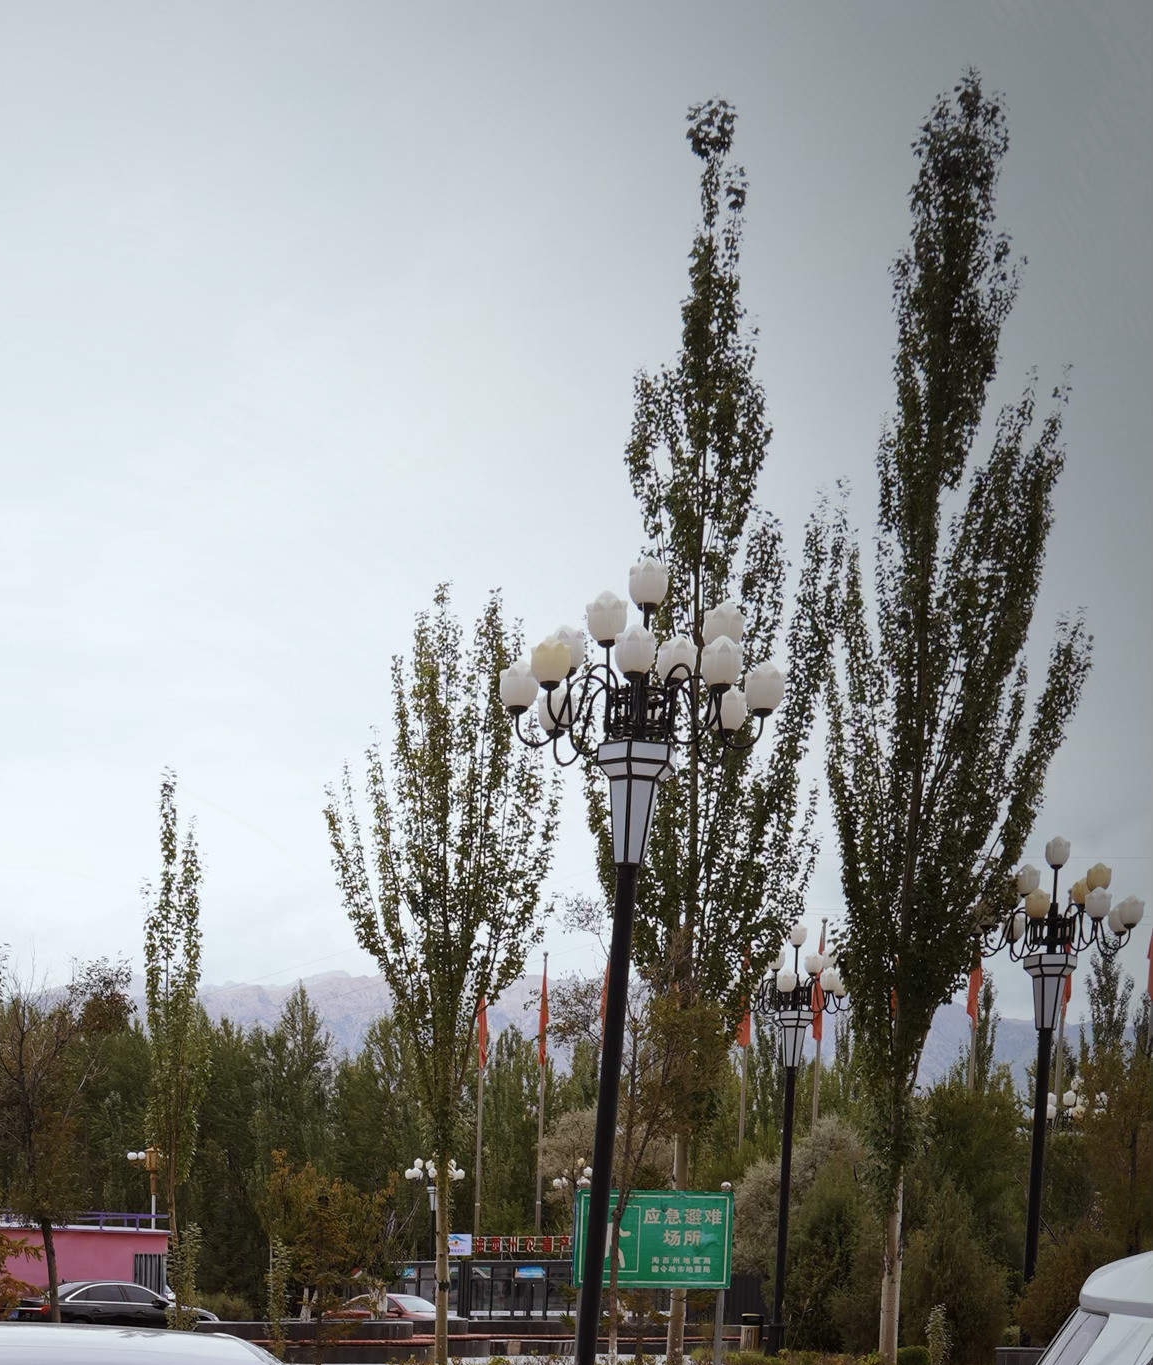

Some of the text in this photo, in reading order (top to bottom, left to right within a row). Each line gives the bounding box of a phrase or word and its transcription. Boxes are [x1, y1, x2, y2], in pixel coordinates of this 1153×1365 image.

[643, 1208, 722, 1225] 应急避难
[663, 1229, 701, 1246] 场所
